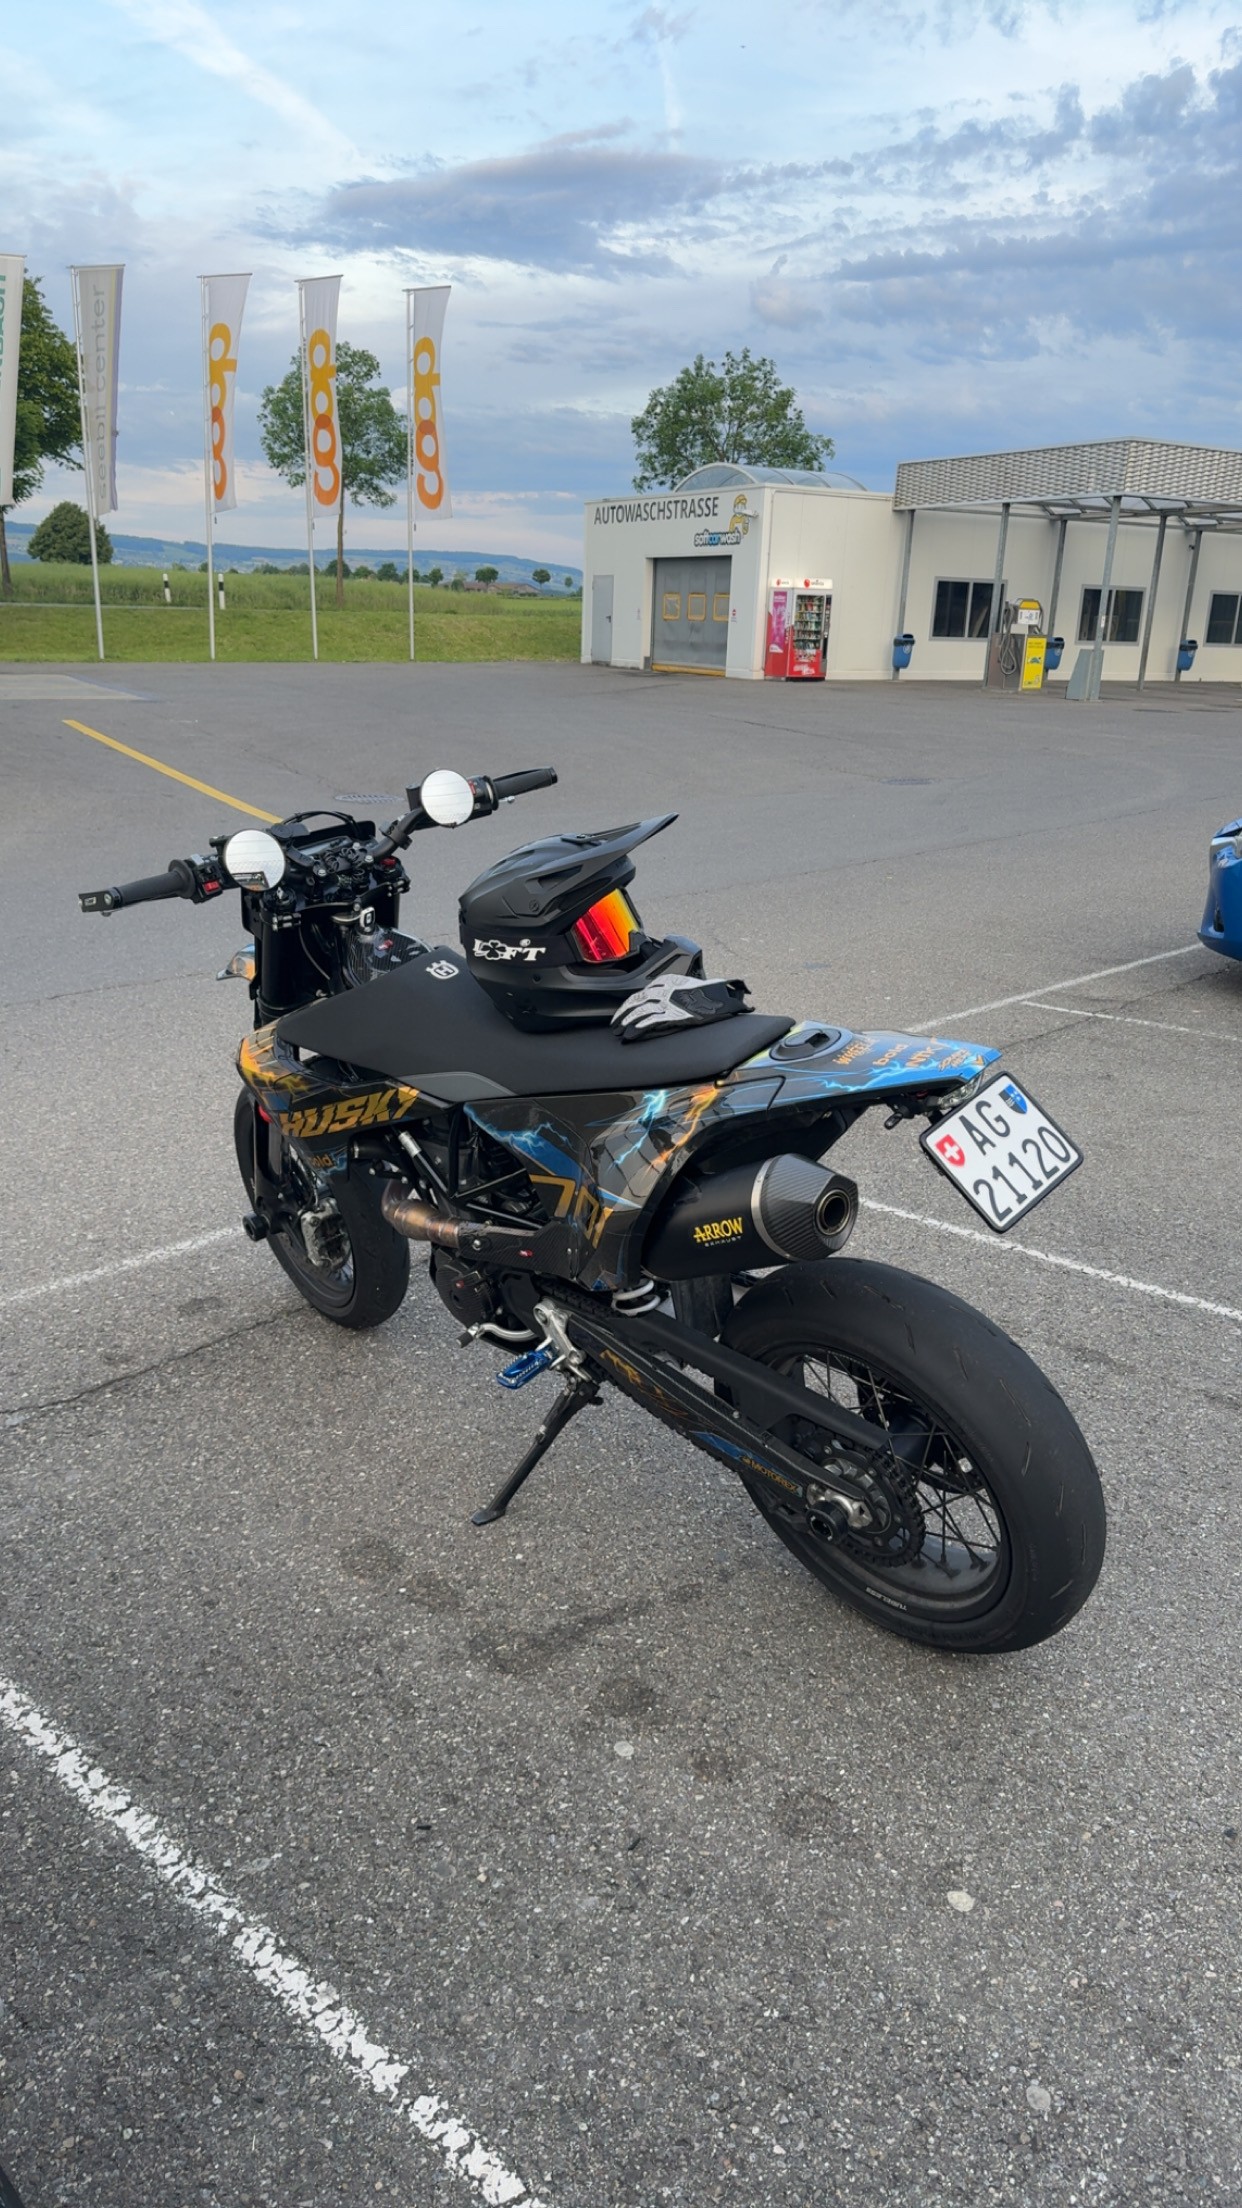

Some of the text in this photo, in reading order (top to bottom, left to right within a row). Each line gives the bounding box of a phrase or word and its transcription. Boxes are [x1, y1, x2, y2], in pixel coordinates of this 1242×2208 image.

[92, 284, 106, 393] center
[209, 322, 238, 500] coop
[308, 328, 341, 506] coop
[413, 336, 444, 510] coop
[593, 496, 720, 525] AUTOWASCHSTRASSE
[279, 1086, 420, 1138] HUSKY
[958, 1100, 1011, 1156] AG
[972, 1126, 1071, 1222] 21120
[693, 1216, 744, 1243] ARROW
